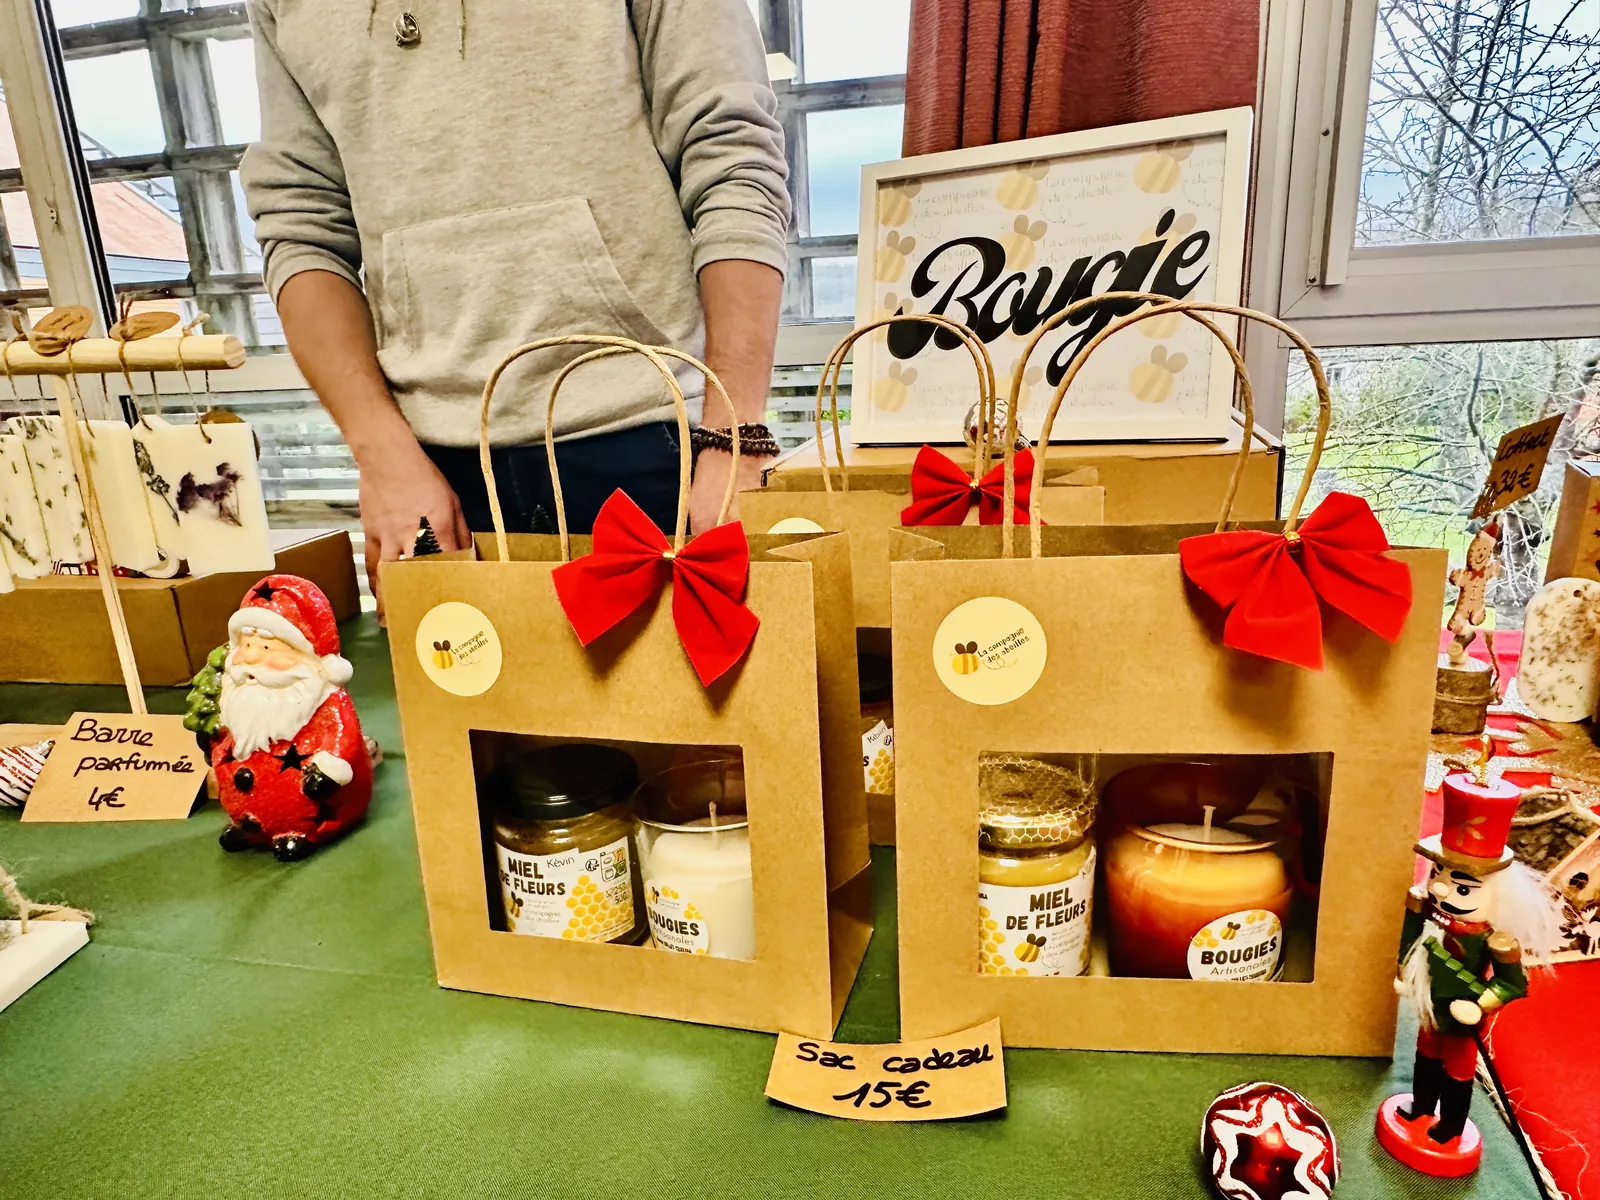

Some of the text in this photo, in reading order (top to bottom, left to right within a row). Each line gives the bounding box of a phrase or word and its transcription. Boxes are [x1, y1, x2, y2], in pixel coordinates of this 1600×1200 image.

[886, 207, 1212, 387] Bougie
[977, 627, 1025, 658] La compagnie
[987, 635, 1030, 664] des abeilles
[70, 718, 154, 747] Barre
[73, 751, 195, 778] parfumée
[88, 786, 126, 811] 4€
[508, 857, 544, 880] MIEL
[546, 856, 575, 869] Kévin
[514, 877, 566, 896] FLEURS
[1029, 887, 1073, 912] MIEL
[1005, 915, 1028, 931] DE
[1035, 898, 1086, 930] FLEURS
[1200, 936, 1277, 965] BOUGIES
[796, 1042, 994, 1074] Sac cadeau
[833, 1080, 932, 1109] 15€
